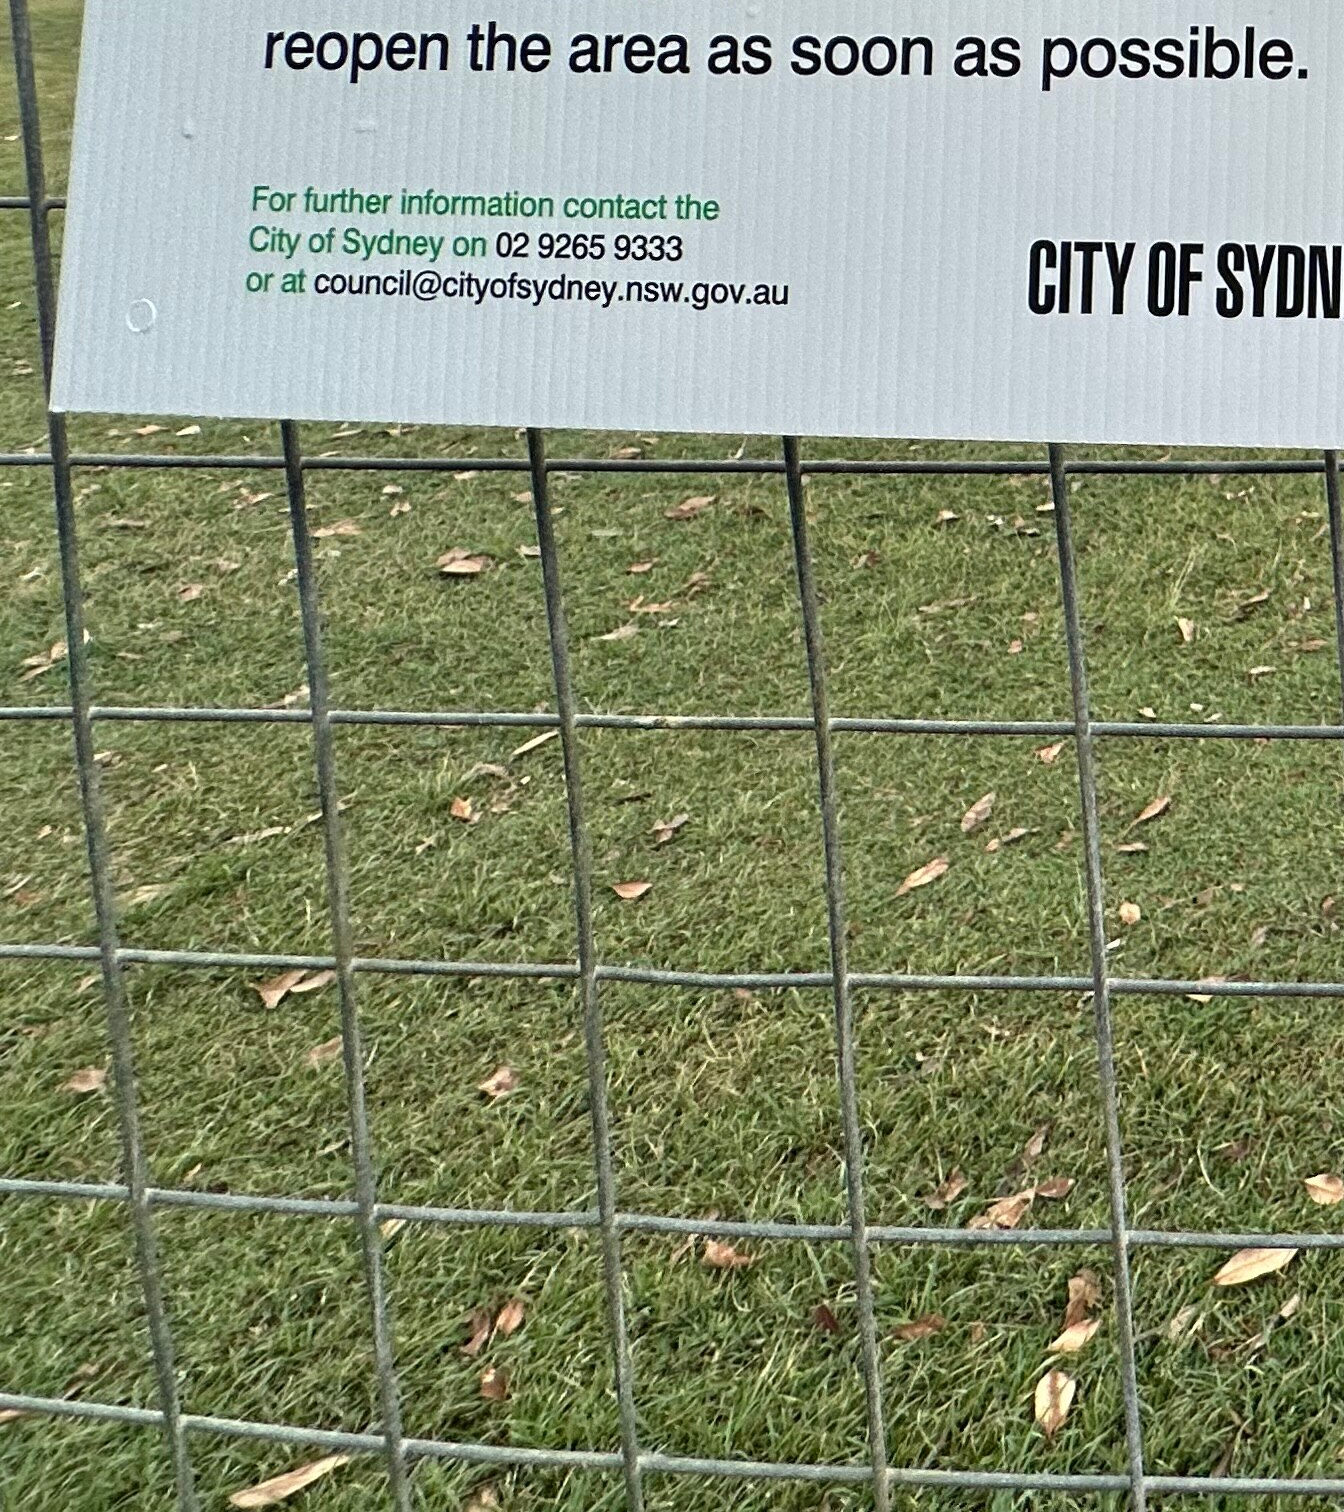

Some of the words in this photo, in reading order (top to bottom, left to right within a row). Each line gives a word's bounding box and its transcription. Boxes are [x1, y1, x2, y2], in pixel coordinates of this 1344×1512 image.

[263, 31, 449, 85] reopen
[466, 20, 552, 74] the
[567, 33, 691, 75] area
[707, 34, 773, 76] as
[790, 35, 934, 77] soon
[953, 36, 1021, 78] as
[1041, 25, 1308, 92] possible.
[251, 185, 298, 213] For
[303, 185, 393, 215] further
[400, 187, 554, 218] information
[562, 193, 668, 220] contact
[674, 193, 721, 221] the
[248, 225, 302, 260] City
[308, 226, 337, 254] of
[341, 227, 445, 264] Sydney
[452, 235, 488, 258] on
[495, 231, 530, 259] 02
[537, 232, 606, 261] 9265
[613, 234, 684, 262] 9333
[245, 271, 275, 293] or
[280, 268, 307, 294] at
[313, 268, 789, 311] council@cityofsydney.nsw.gov.au
[1027, 239, 1137, 315] CITY
[1147, 241, 1204, 318] OF
